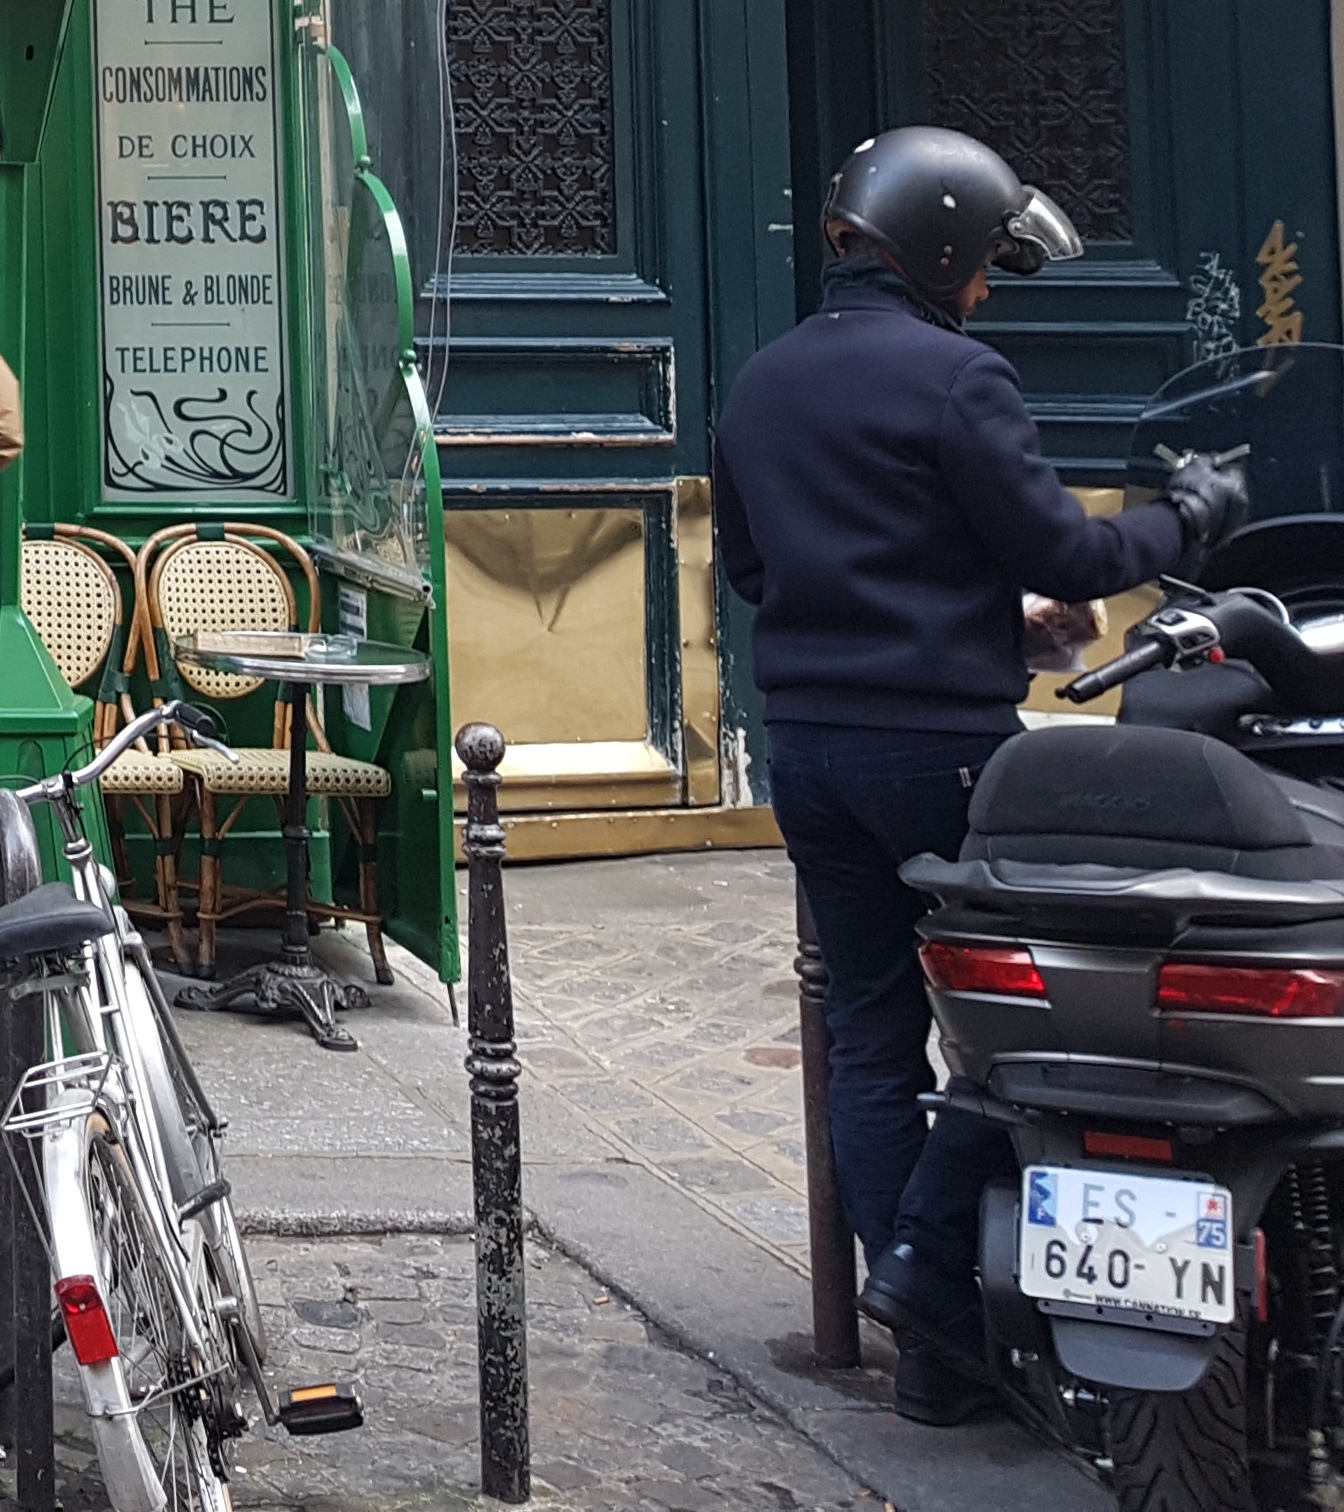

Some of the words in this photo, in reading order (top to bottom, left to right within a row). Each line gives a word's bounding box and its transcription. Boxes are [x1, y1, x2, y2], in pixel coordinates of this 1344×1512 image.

[102, 65, 268, 104] CONSOMMATIONS
[118, 134, 155, 160] DE
[170, 133, 257, 160] CHOIX
[107, 198, 268, 246] BIERE
[109, 274, 173, 306] BRUNE
[181, 279, 199, 306] &
[203, 274, 274, 306] BLONDE
[114, 345, 270, 374] TELEPHONE
[1036, 1208, 1048, 1221] F
[1198, 1224, 1226, 1245] 75
[1168, 1256, 1226, 1307] YN
